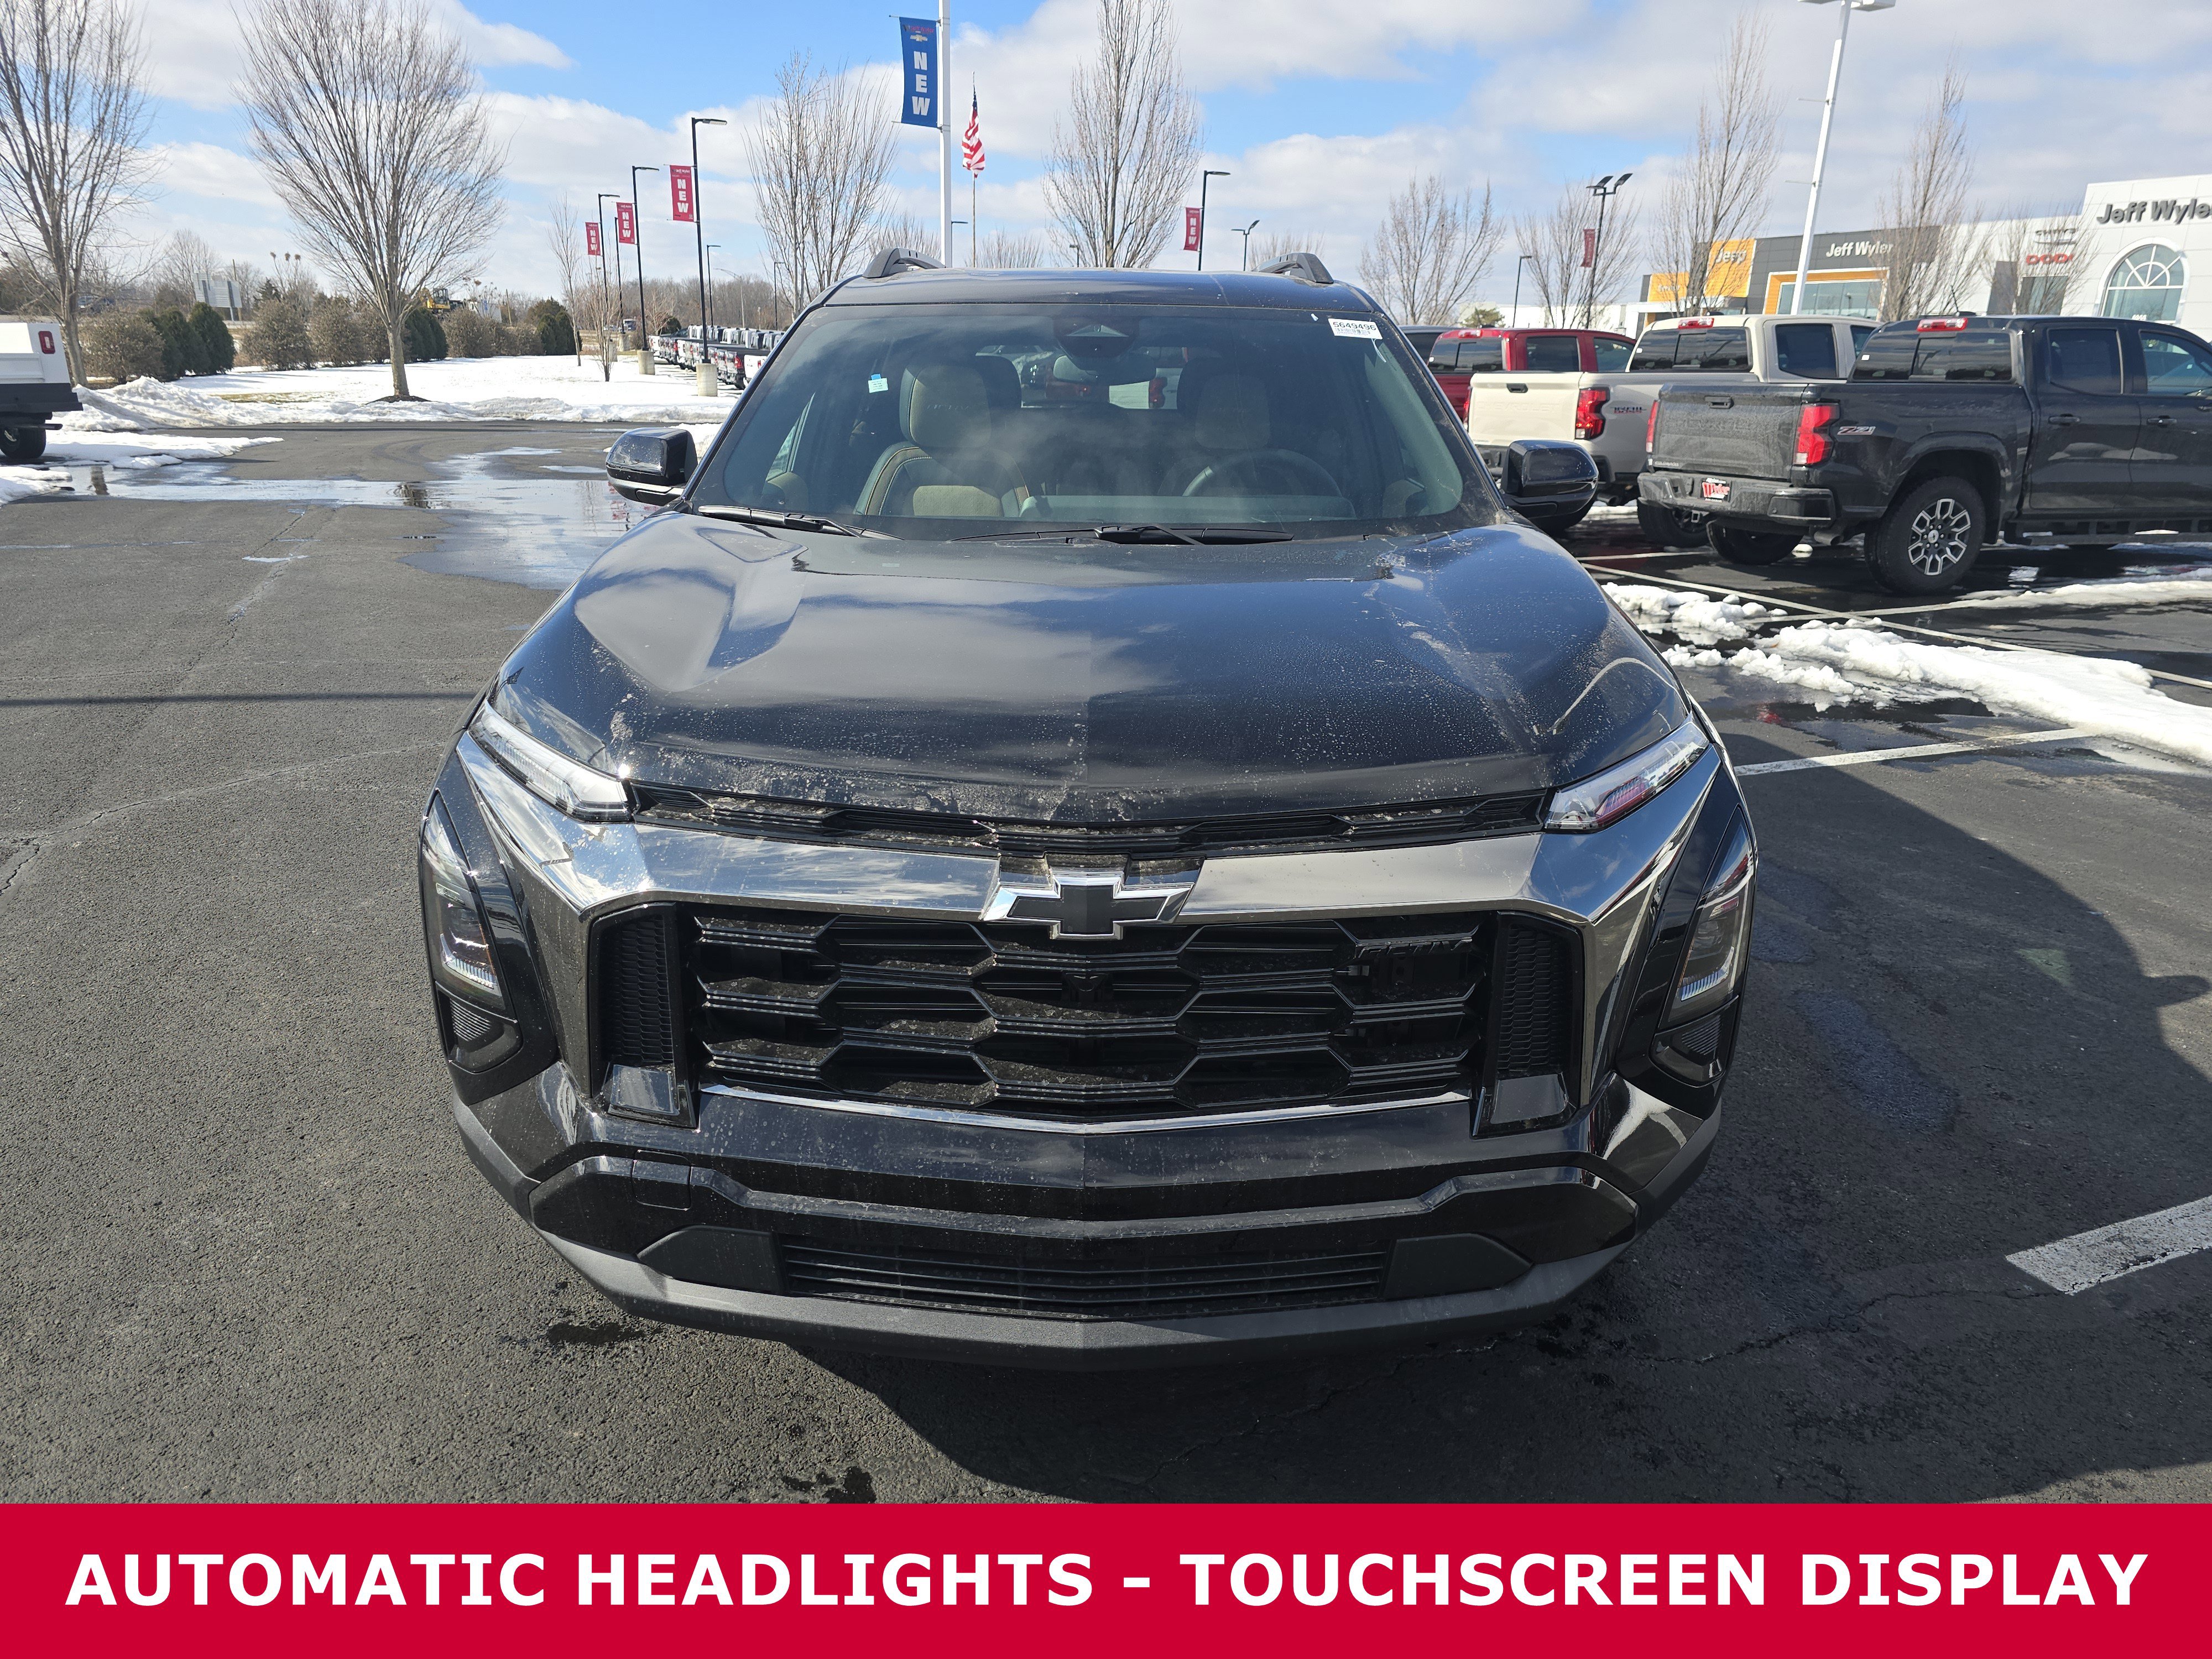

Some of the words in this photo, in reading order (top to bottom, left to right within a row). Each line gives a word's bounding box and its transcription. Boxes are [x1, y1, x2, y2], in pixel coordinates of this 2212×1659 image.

[912, 51, 930, 116] NEW
[677, 179, 689, 213] NEW
[2097, 201, 2147, 224] Jeff
[2151, 198, 2212, 225] Wyle
[622, 212, 631, 238] NEW
[1188, 217, 1197, 245] NEW
[1715, 248, 1747, 264] Jeep
[1826, 242, 1854, 257] Jeff
[1855, 241, 1893, 257] Wyler
[1333, 321, 1376, 331] 5649496
